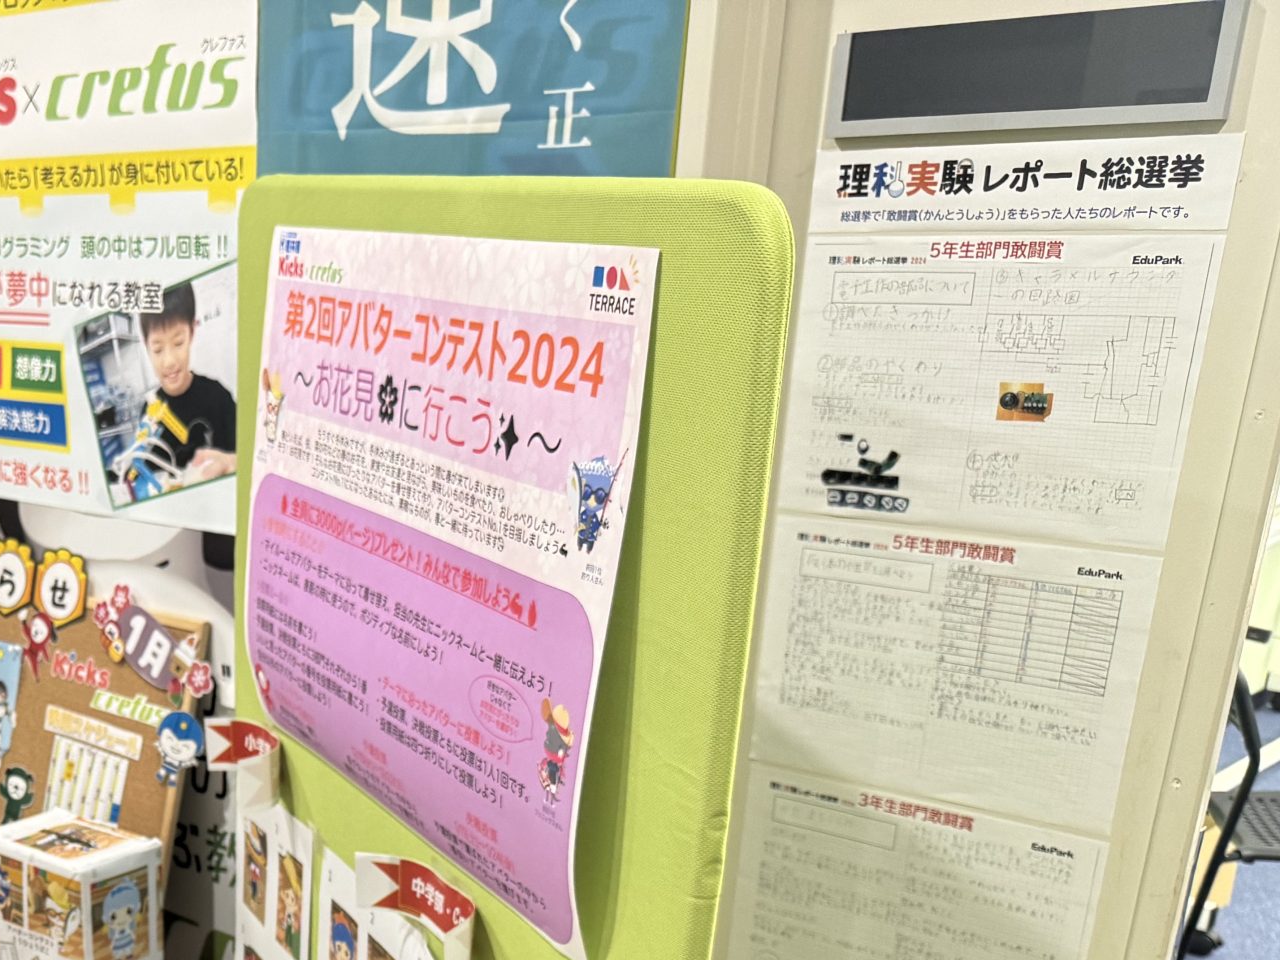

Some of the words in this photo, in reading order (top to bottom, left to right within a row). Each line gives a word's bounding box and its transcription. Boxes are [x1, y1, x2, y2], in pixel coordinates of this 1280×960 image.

[44, 42, 247, 122] crefus
[930, 240, 1065, 261] 5年生部門敢闘賞
[1132, 255, 1183, 266] EduPark
[589, 293, 636, 316] TERRACE
[284, 289, 606, 398] 第2回アバターコンテスト2024
[15, 354, 57, 382] 想像力
[893, 534, 1017, 565] 5年生部門敢闘賞
[1077, 567, 1123, 581] EduPark
[125, 613, 173, 680] 1月
[49, 651, 112, 691] Kicks
[858, 792, 975, 833] 3年生部門敢闘賞
[1030, 842, 1074, 859] EduPark
